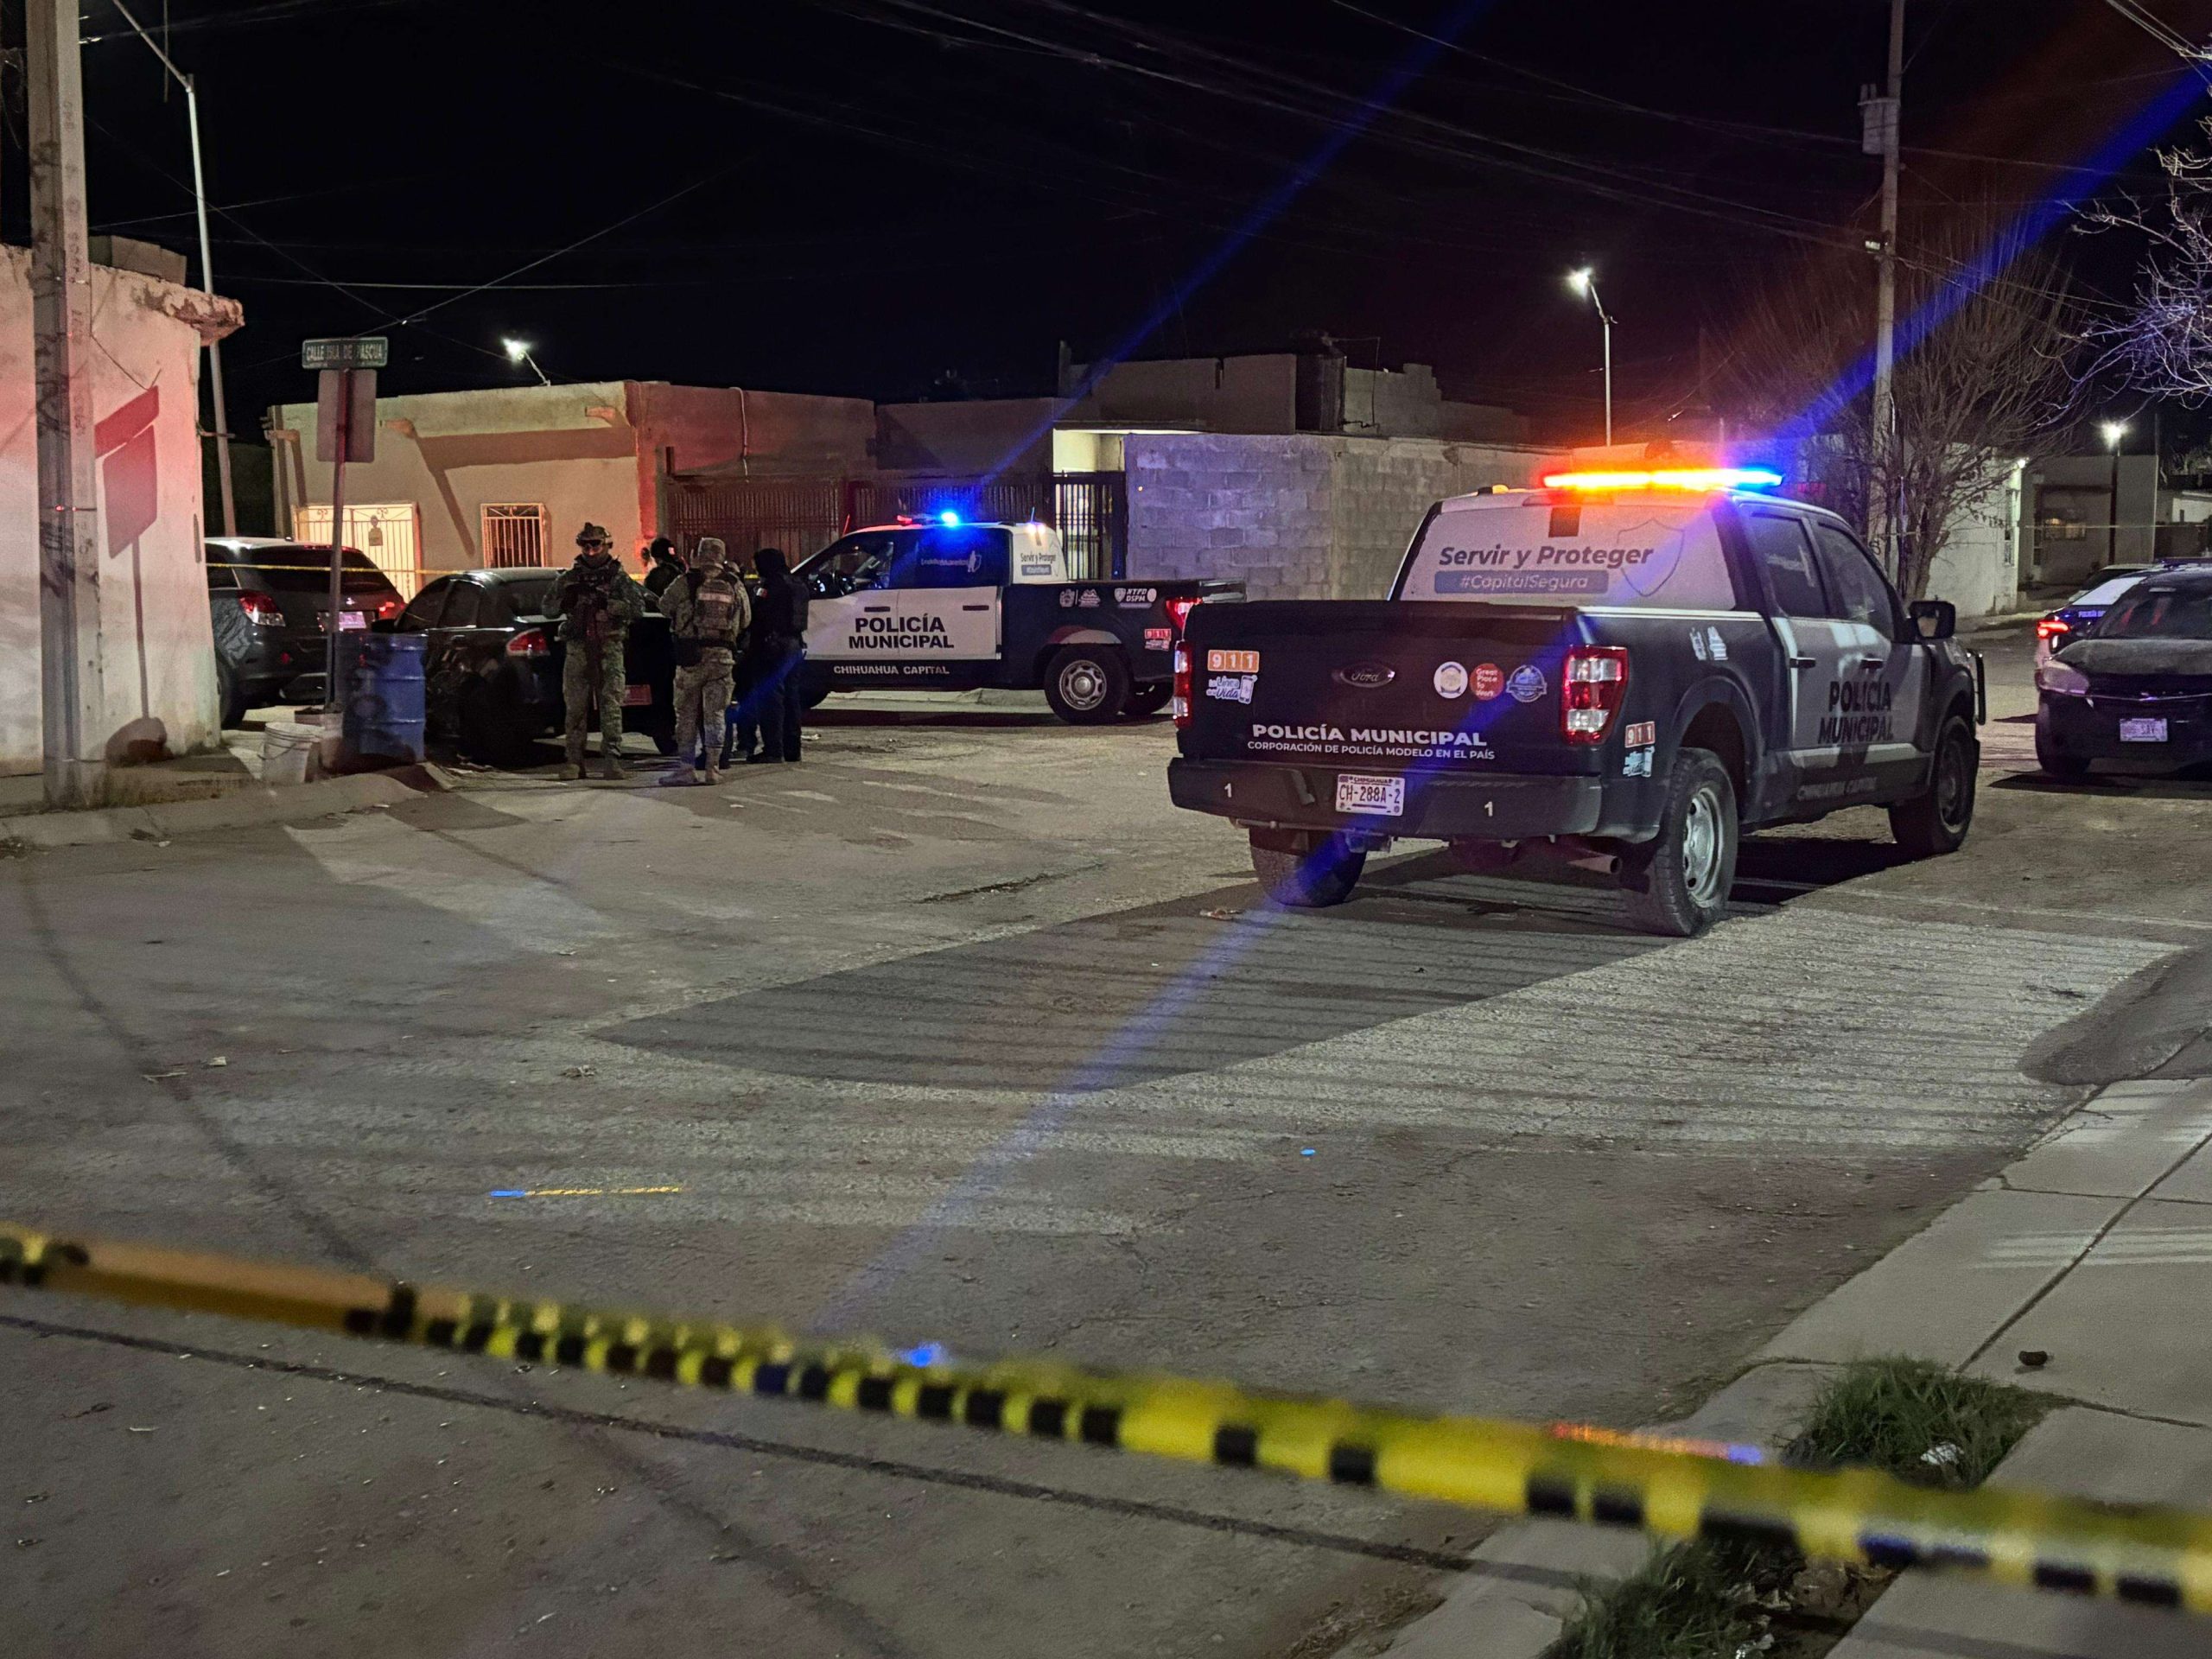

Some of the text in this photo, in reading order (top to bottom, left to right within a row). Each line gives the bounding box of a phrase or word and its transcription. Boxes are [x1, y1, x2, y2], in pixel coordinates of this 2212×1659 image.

[307, 345, 324, 361] CALLE
[1439, 544, 1654, 569] Servir y Proteger
[1459, 574, 1588, 591] #CapitalSegura
[855, 613, 945, 632] POLICÍA
[849, 634, 955, 649] MUNICIPAL
[833, 664, 950, 675] CHIHUAHUA CAPITAL
[1211, 652, 1255, 670] 911
[1350, 671, 1382, 683] Ford
[1252, 723, 1488, 747] POLICÍA MUNICIPAL
[1628, 726, 1653, 745] 911
[1817, 715, 1895, 745] MUNICIPAL
[1247, 741, 1496, 760] CORPORACIÓN DE POLICÍA MODELO EN EL PAÍS
[1224, 782, 1234, 798] 1
[1339, 784, 1402, 804] CH-288A-2
[1484, 801, 1494, 817] 1
